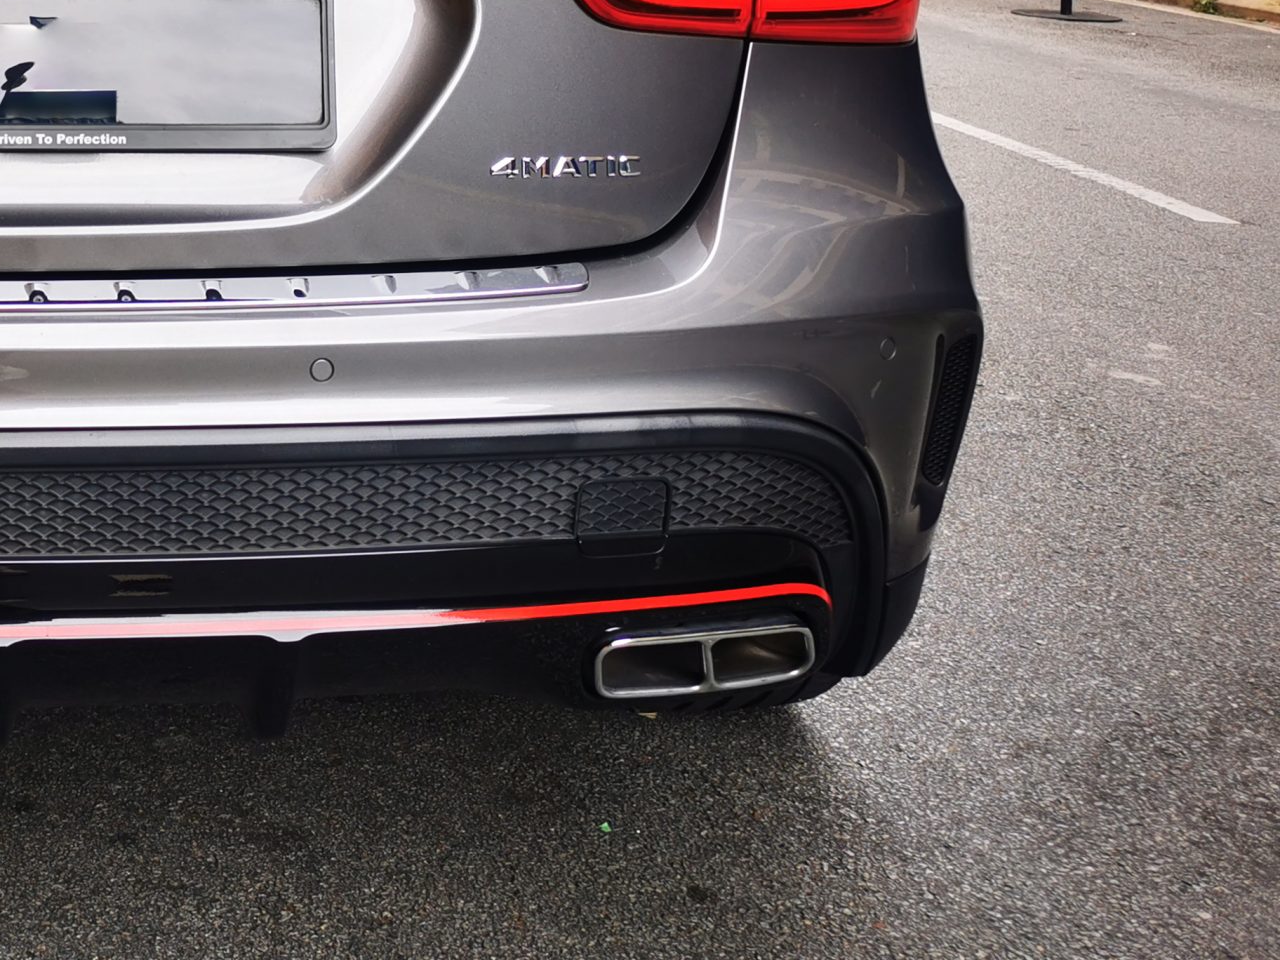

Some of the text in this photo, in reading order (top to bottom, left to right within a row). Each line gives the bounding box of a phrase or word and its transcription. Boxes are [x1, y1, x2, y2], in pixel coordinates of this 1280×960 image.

[36, 133, 53, 145] To
[56, 133, 127, 145] Perfection
[490, 155, 641, 178] 4MATIC
